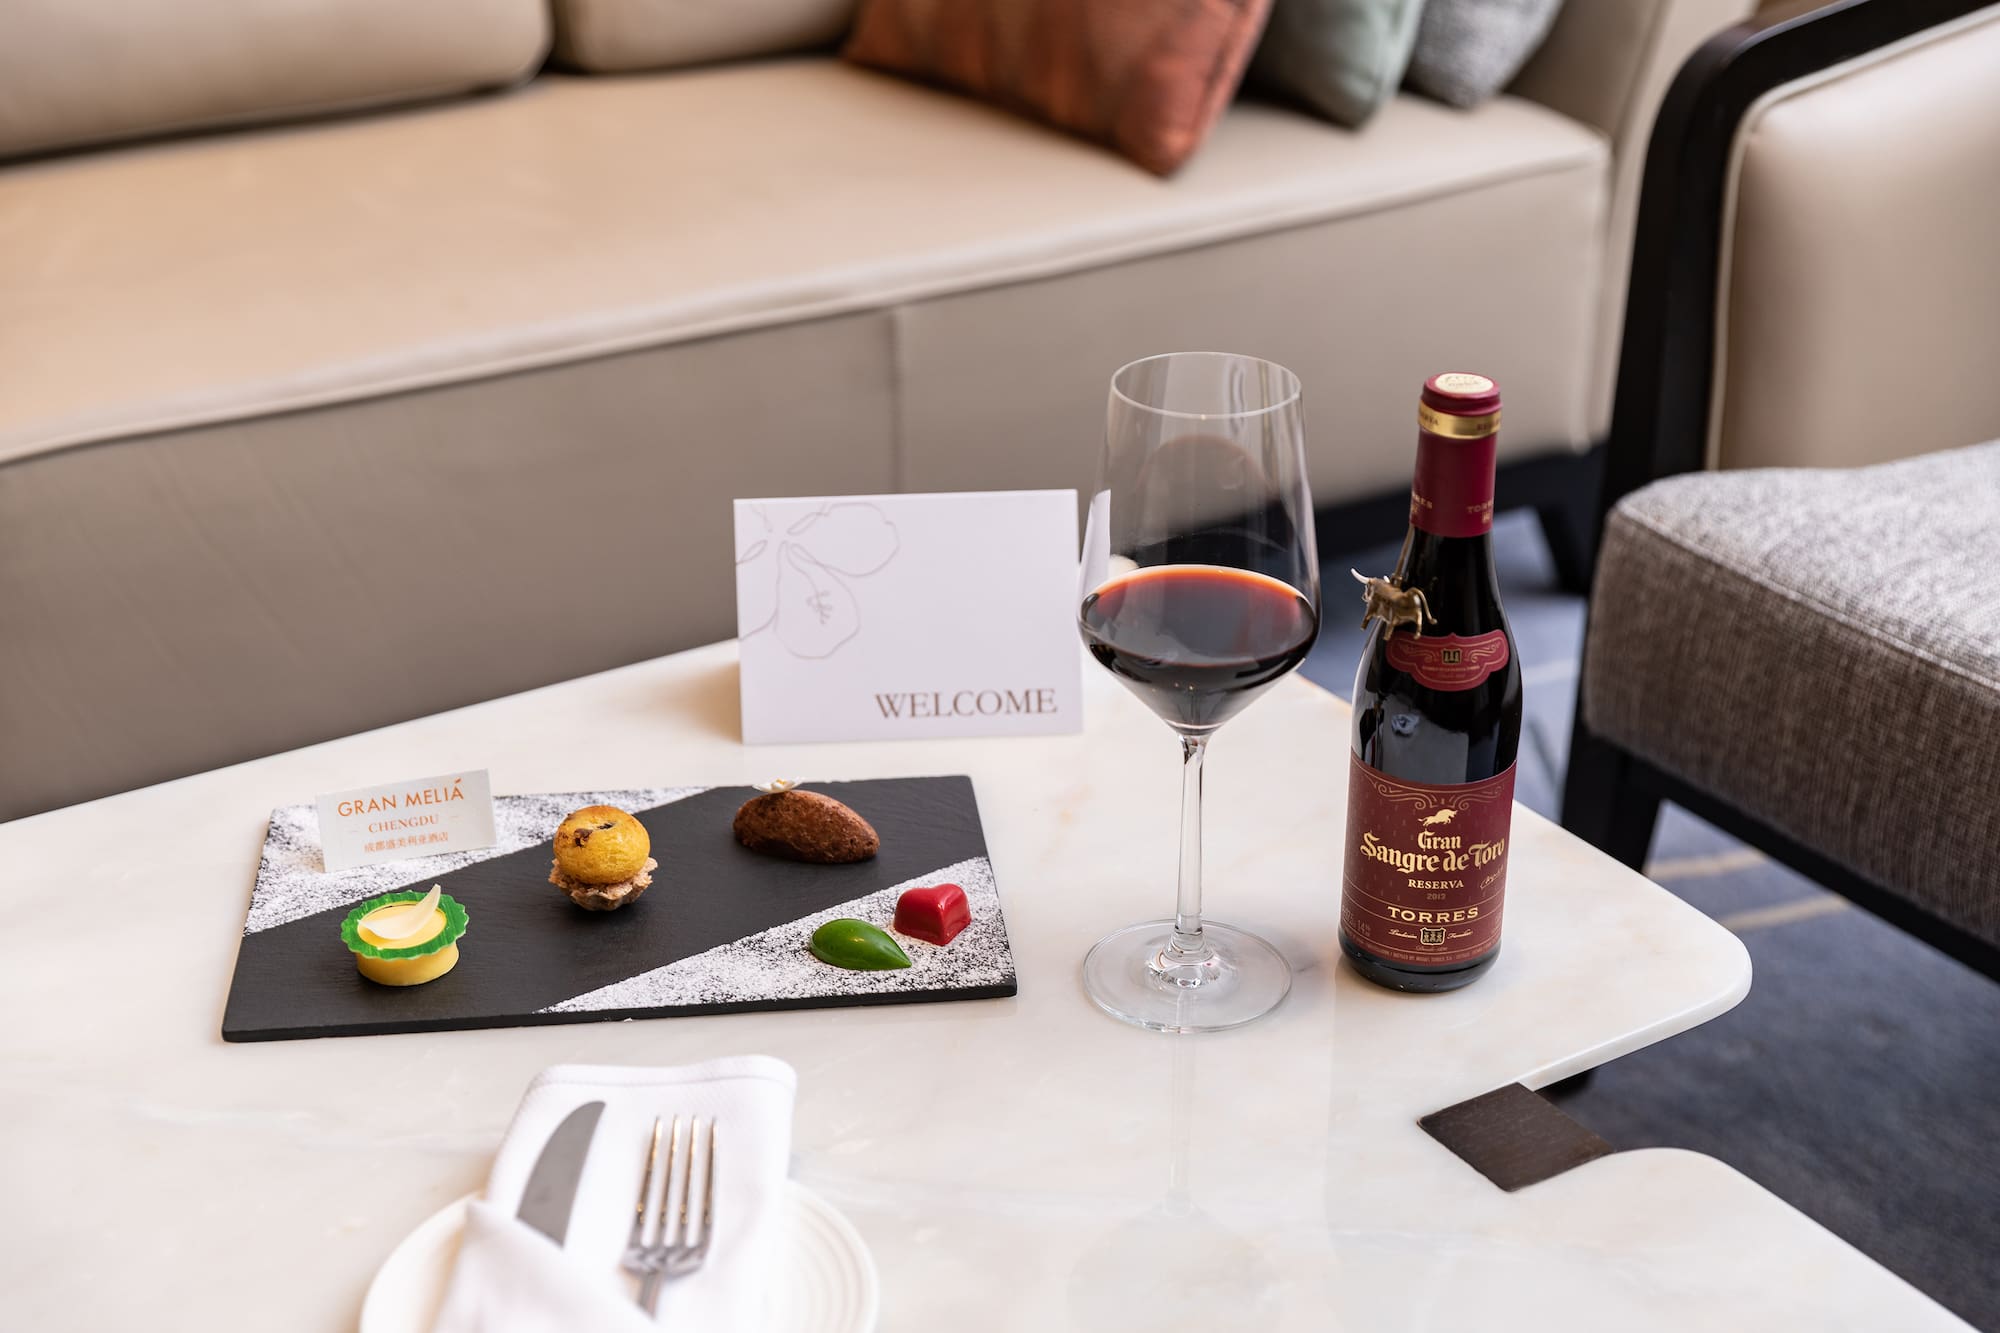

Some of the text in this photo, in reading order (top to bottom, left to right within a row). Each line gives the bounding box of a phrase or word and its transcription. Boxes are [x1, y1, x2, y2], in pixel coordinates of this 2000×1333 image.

[875, 688, 1058, 719] WELCOME
[337, 778, 465, 817] GRAN MELIÁ
[368, 814, 440, 834] CHENGDU
[1359, 830, 1505, 874] Sangre de Toro
[1417, 828, 1462, 852] Gran
[1407, 879, 1465, 890] RESERVA
[1387, 906, 1479, 924] TORRES
